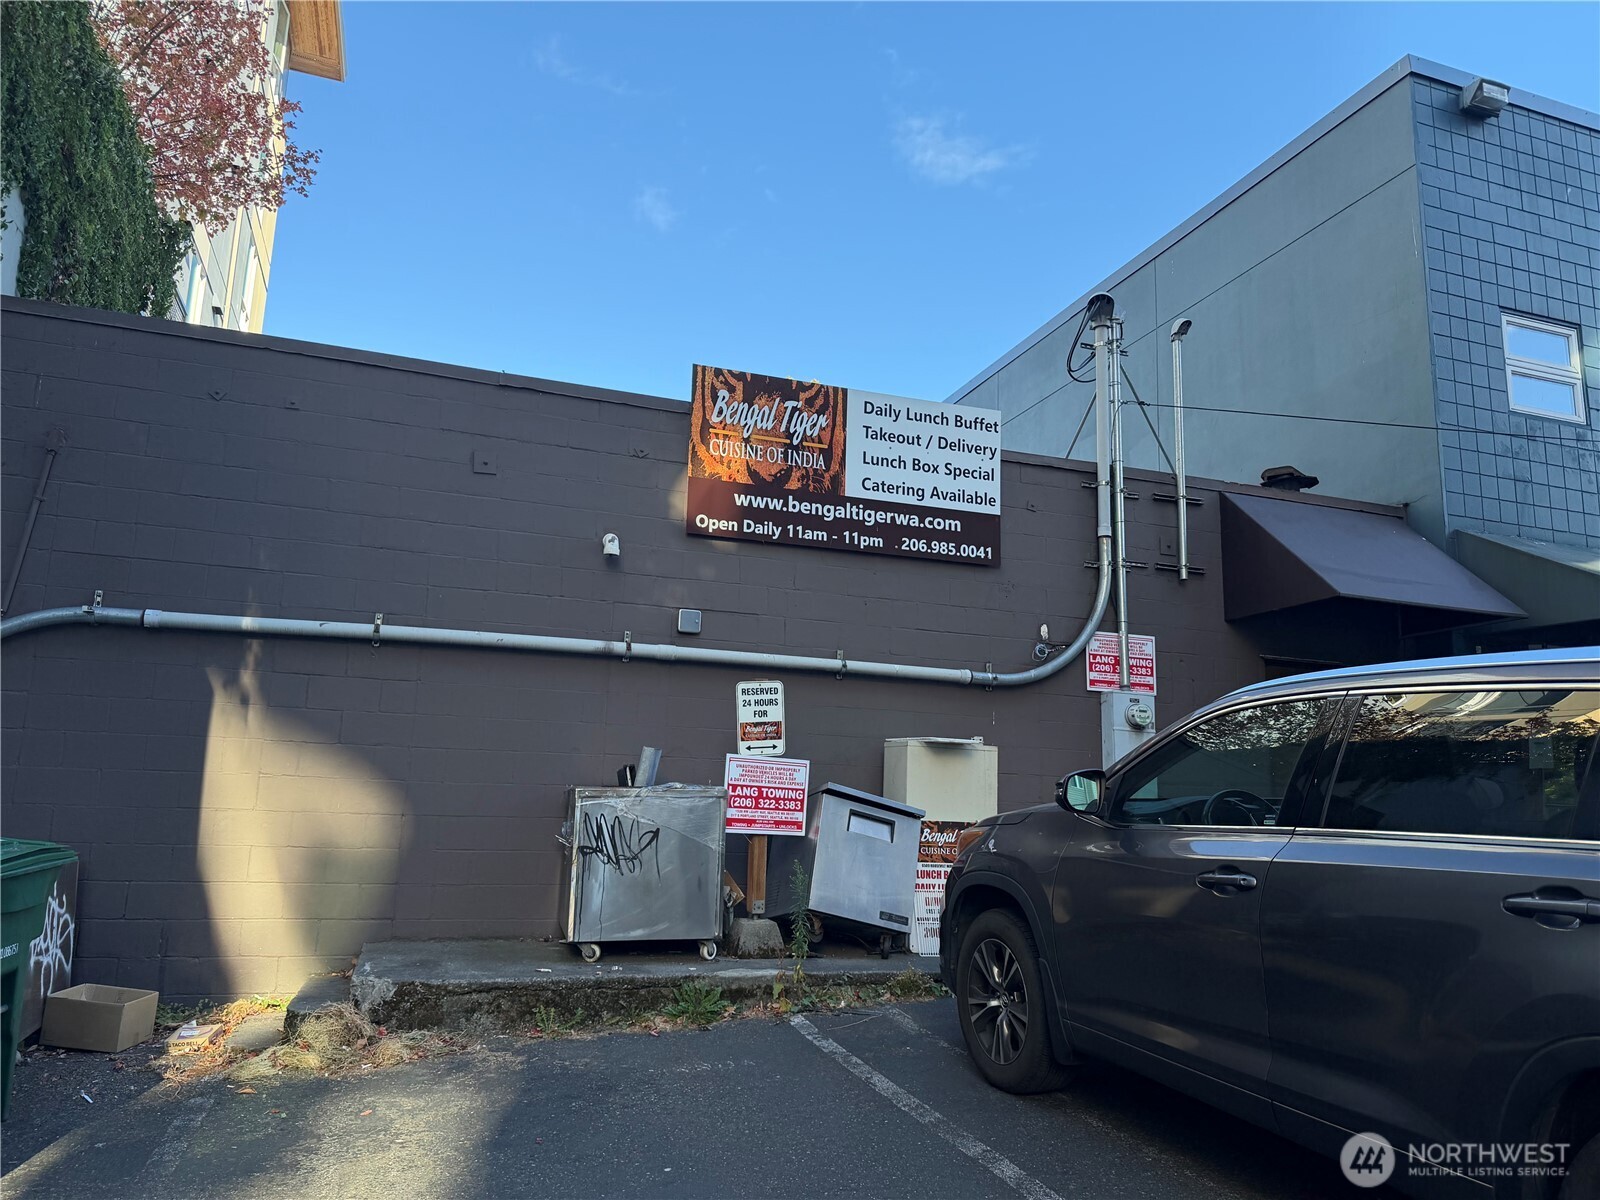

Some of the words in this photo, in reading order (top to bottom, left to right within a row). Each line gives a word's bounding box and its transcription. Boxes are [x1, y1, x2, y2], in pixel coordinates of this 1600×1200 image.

[711, 389, 780, 438] Bengal
[780, 401, 829, 446] Tiger
[864, 401, 901, 422] Daily
[906, 407, 949, 426] Lunch
[954, 414, 999, 433] Buffet
[862, 425, 921, 446] Takeout
[926, 435, 933, 449] /
[938, 436, 997, 460] Delivery
[709, 439, 763, 461] CUISINE
[766, 447, 784, 463] OF
[787, 450, 826, 470] INDIA
[862, 451, 906, 470] Lunch
[912, 458, 939, 474] Box
[944, 462, 994, 481] Special
[861, 477, 925, 501] Catering
[930, 486, 996, 507] Available
[733, 493, 961, 532] www.bengaltigerwa.com
[695, 514, 738, 532] Open
[743, 519, 782, 539] Daily
[787, 524, 827, 541] 11am
[843, 531, 883, 549] 11pm
[901, 537, 992, 559] 206.985.0041
[1090, 655, 1115, 664] LANG
[1092, 663, 1113, 673] (206)
[1115, 665, 1152, 675] 3-3383
[741, 687, 779, 696] RESERVED
[742, 699, 752, 707] 24
[754, 698, 779, 706] HOURS
[753, 710, 768, 718] FOR
[728, 786, 758, 797] LANG
[762, 788, 803, 799] TOWING
[731, 797, 755, 808] (206)
[758, 799, 801, 810] 322-3383
[921, 828, 957, 846] Bengal
[920, 847, 951, 855] CUISINE
[916, 869, 942, 880] LUNCH
